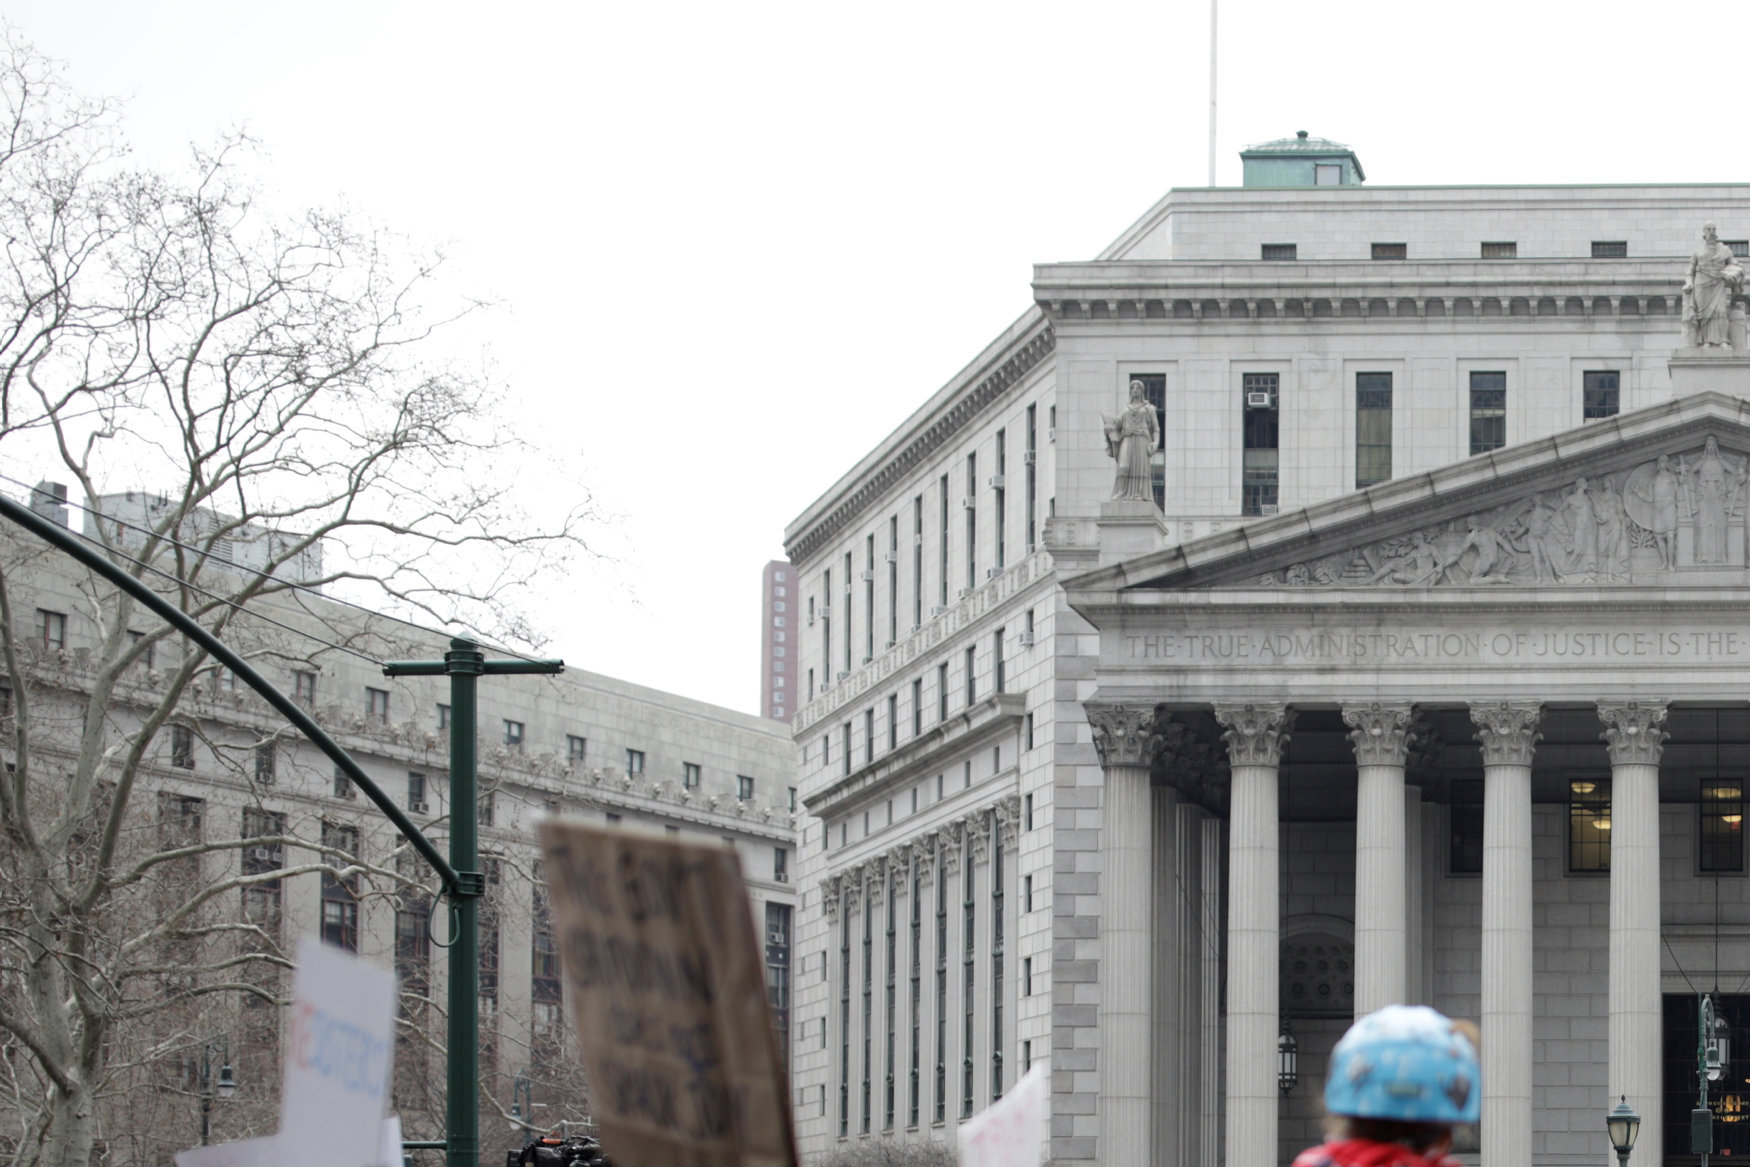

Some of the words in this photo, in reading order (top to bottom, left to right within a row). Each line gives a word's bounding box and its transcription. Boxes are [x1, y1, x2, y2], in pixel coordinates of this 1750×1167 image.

[1126, 635, 1175, 658] THE
[1185, 635, 1249, 658] TRUE
[1258, 633, 1481, 658] ADMINISTRATION
[1491, 633, 1526, 656] OF
[1532, 632, 1646, 656] JUSTICE
[1658, 632, 1681, 656] IS
[1690, 632, 1739, 656] THE
